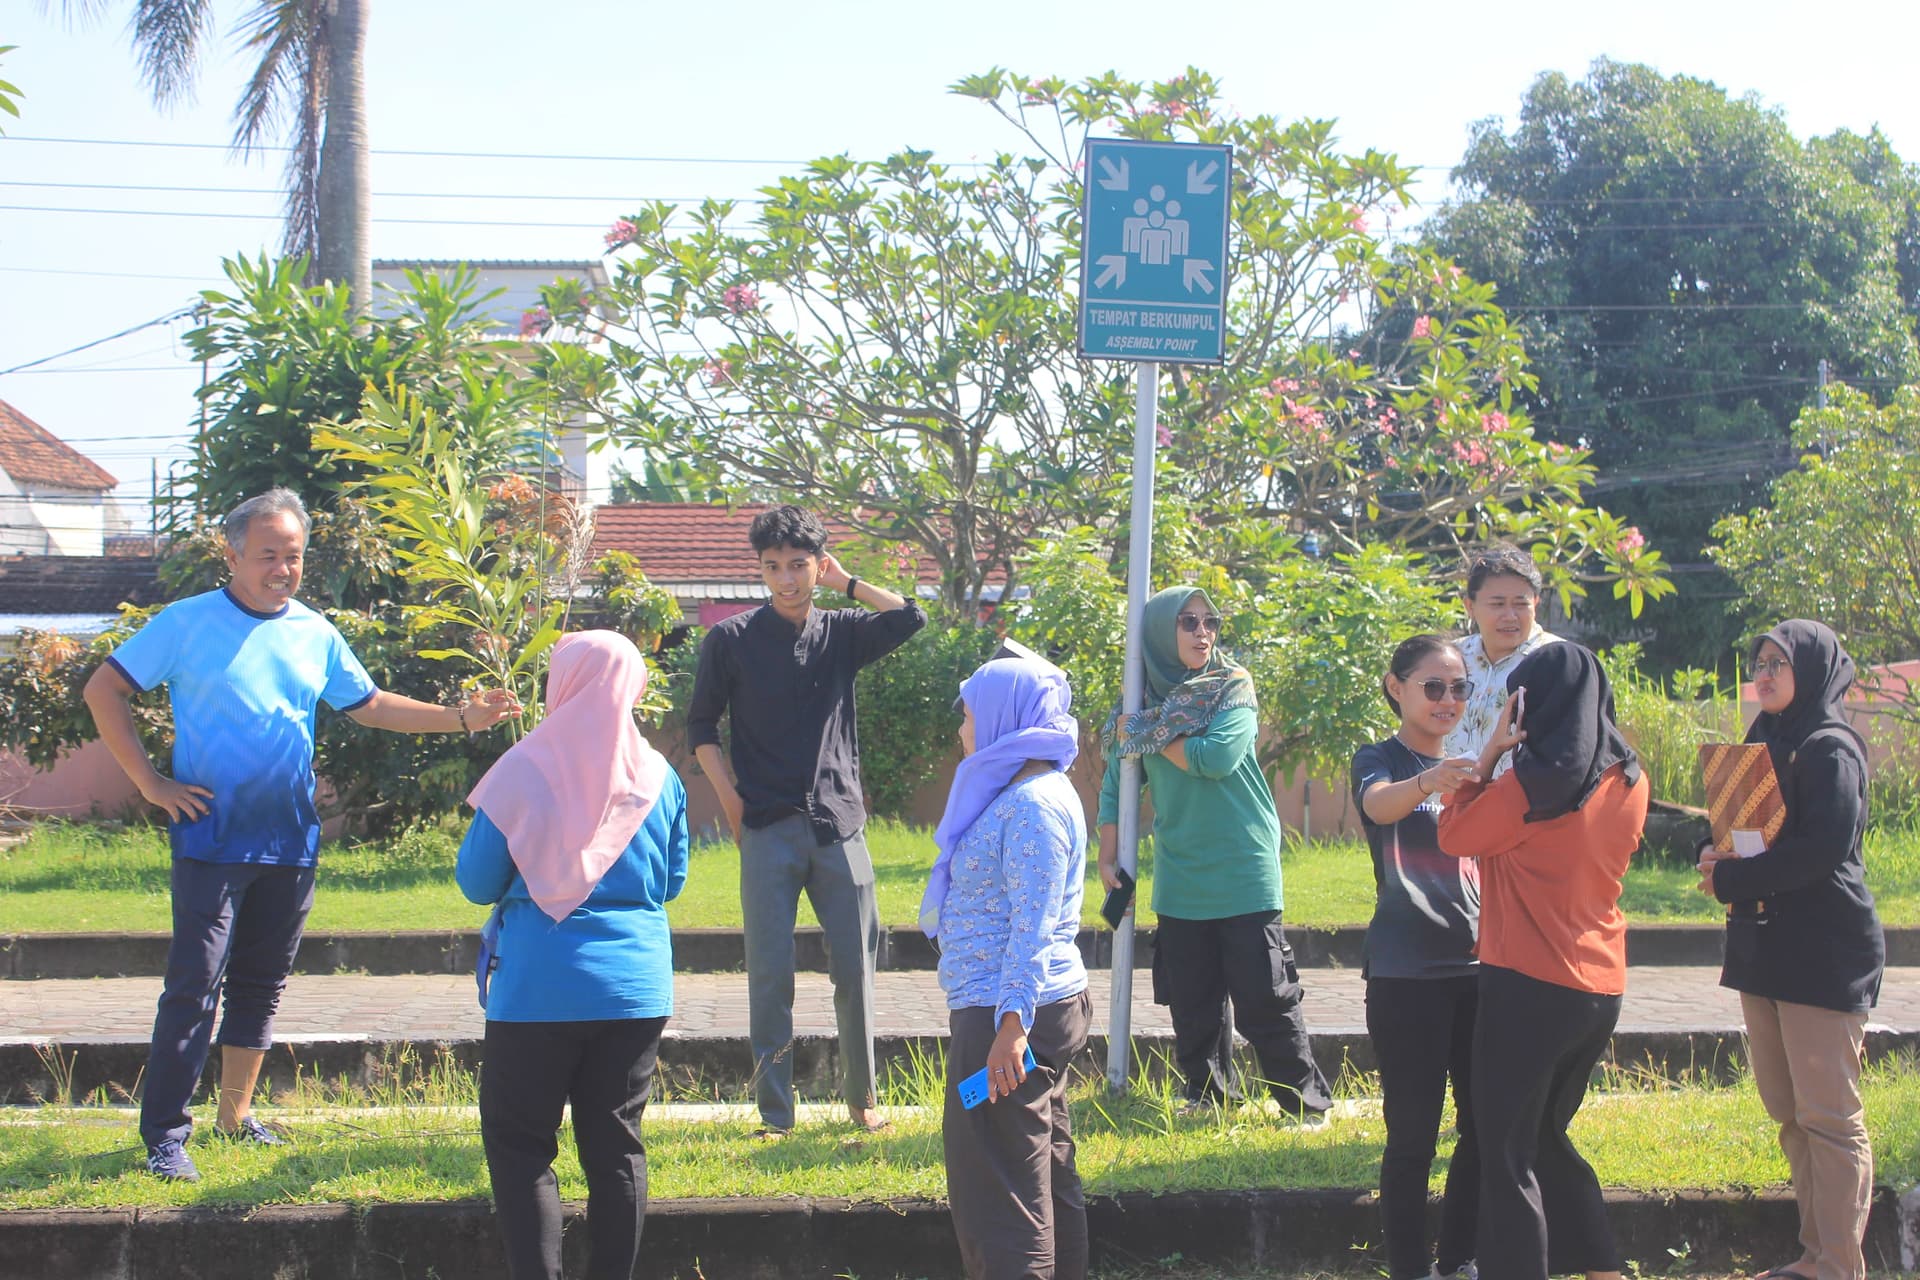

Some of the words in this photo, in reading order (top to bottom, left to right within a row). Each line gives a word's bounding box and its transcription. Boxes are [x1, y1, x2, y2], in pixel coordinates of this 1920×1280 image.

[1089, 309, 1137, 327] TEMPAT
[1140, 312, 1215, 331] BERKUMPUL
[1105, 335, 1162, 350] ASSEMBLY
[1164, 338, 1198, 351] POINT
